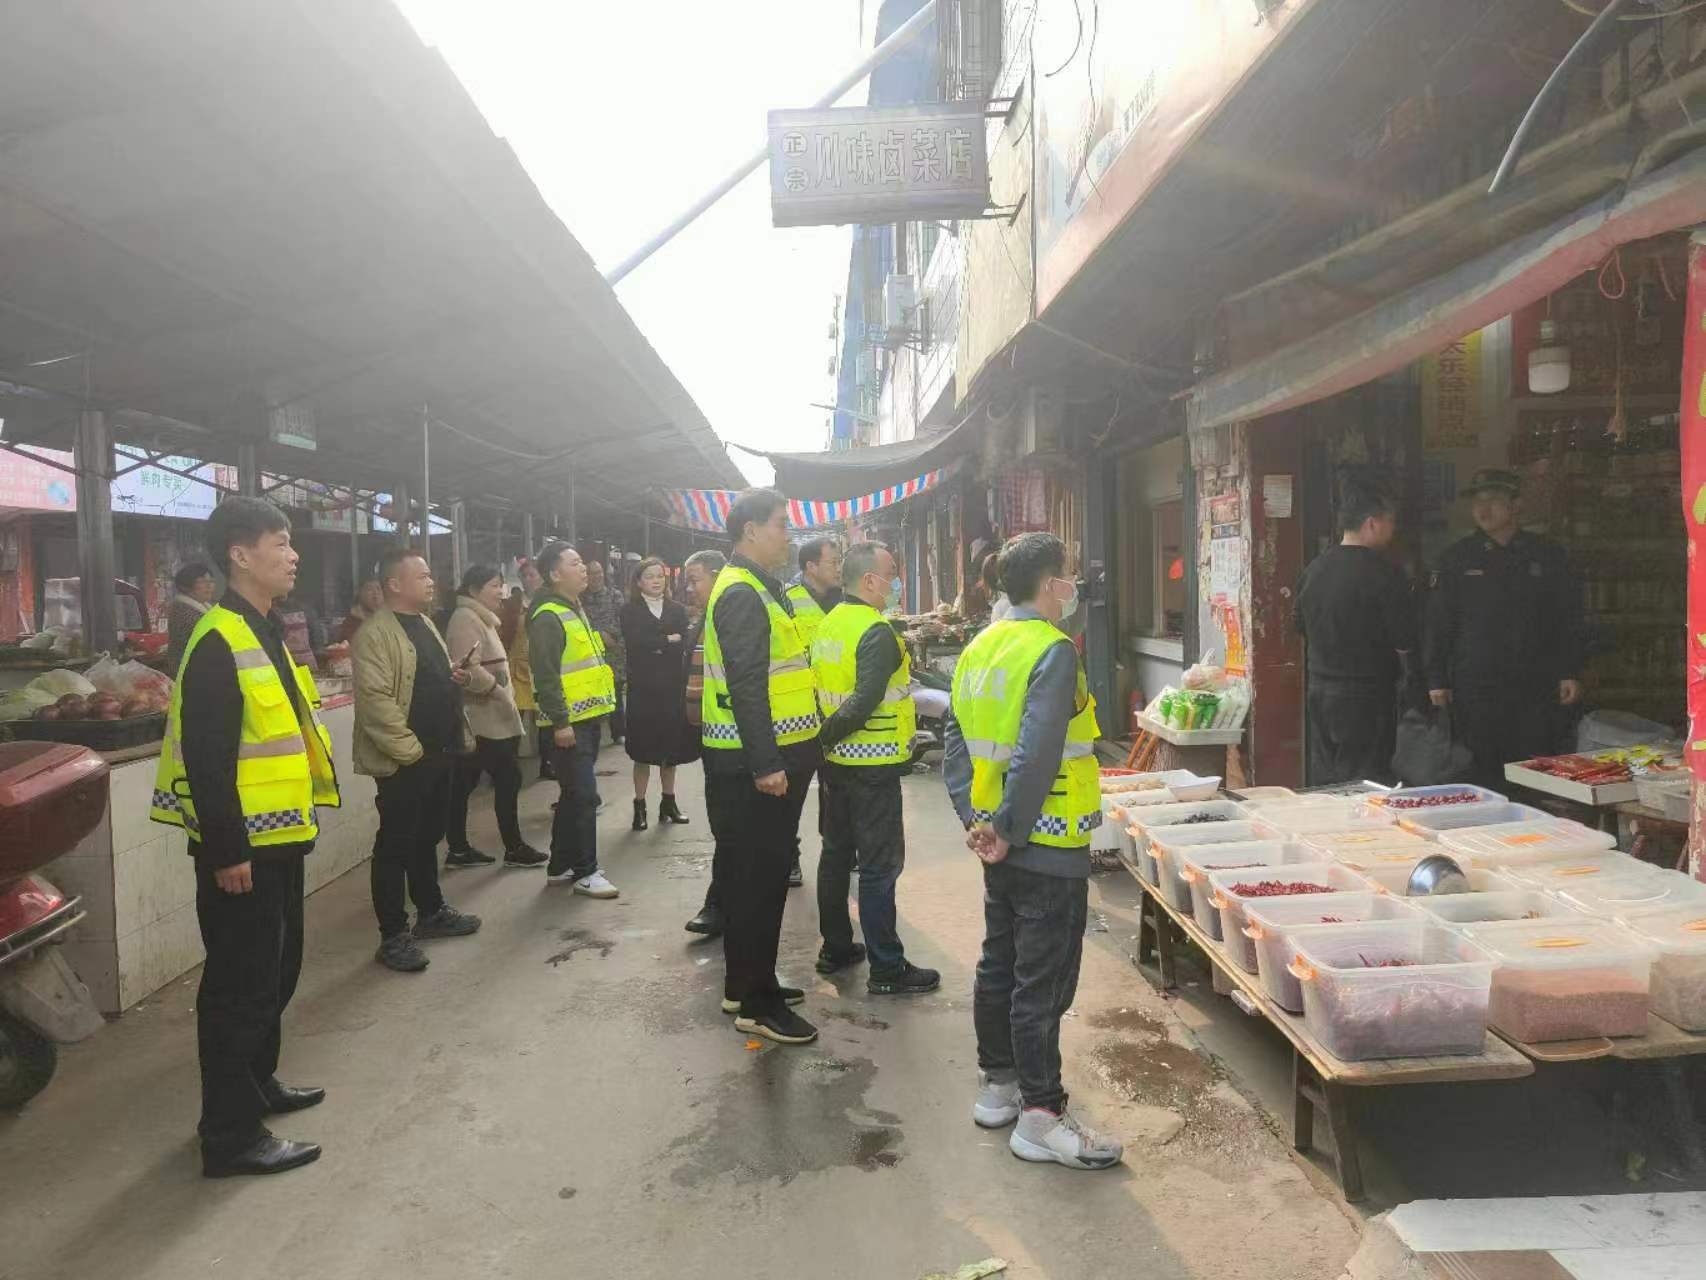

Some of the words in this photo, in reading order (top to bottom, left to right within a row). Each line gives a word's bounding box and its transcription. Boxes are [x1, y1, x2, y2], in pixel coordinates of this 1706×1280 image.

[785, 134, 806, 190] 正宗
[814, 128, 974, 188] 川味卤菜店
